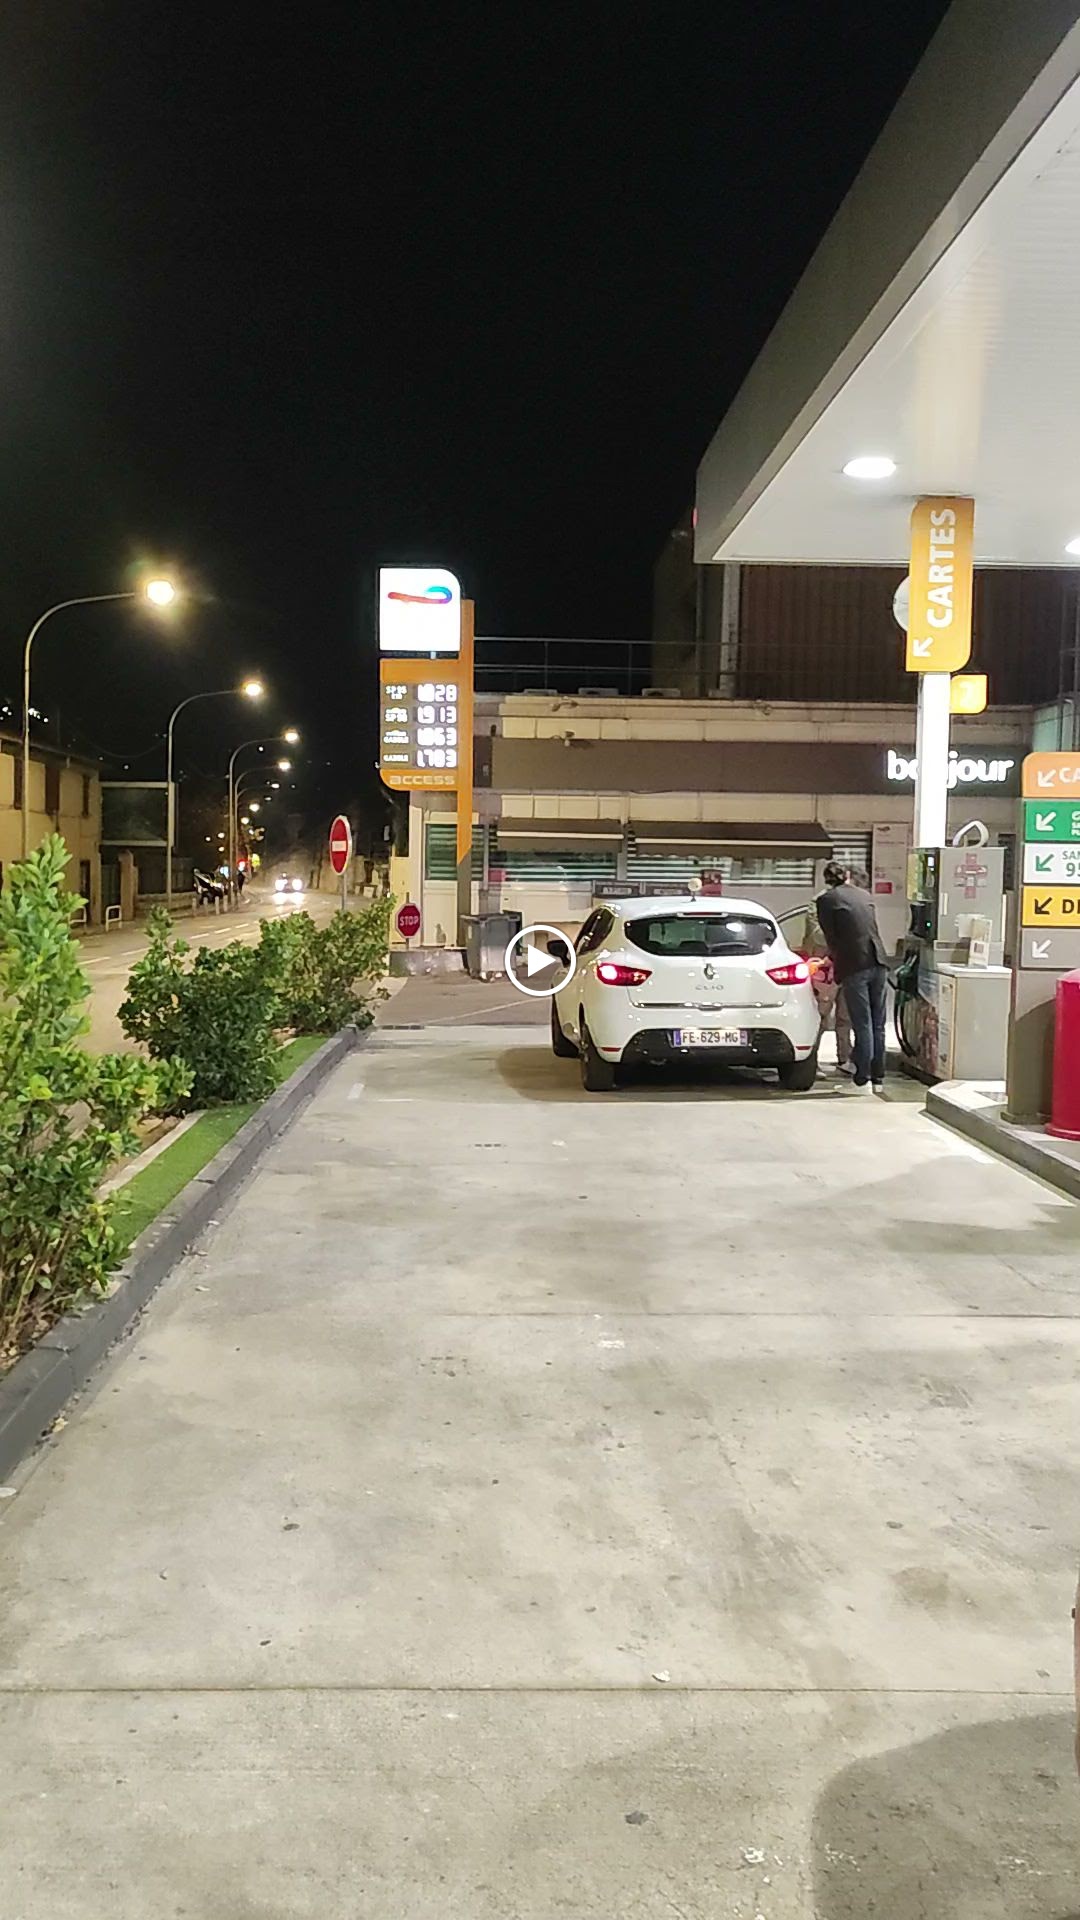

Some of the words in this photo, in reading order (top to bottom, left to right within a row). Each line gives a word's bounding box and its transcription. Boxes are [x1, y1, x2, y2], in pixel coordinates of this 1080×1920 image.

[926, 508, 957, 628] CARTES
[887, 750, 1014, 789] bojour
[399, 915, 419, 926] STOP
[682, 1031, 739, 1044] FE-629-MG
